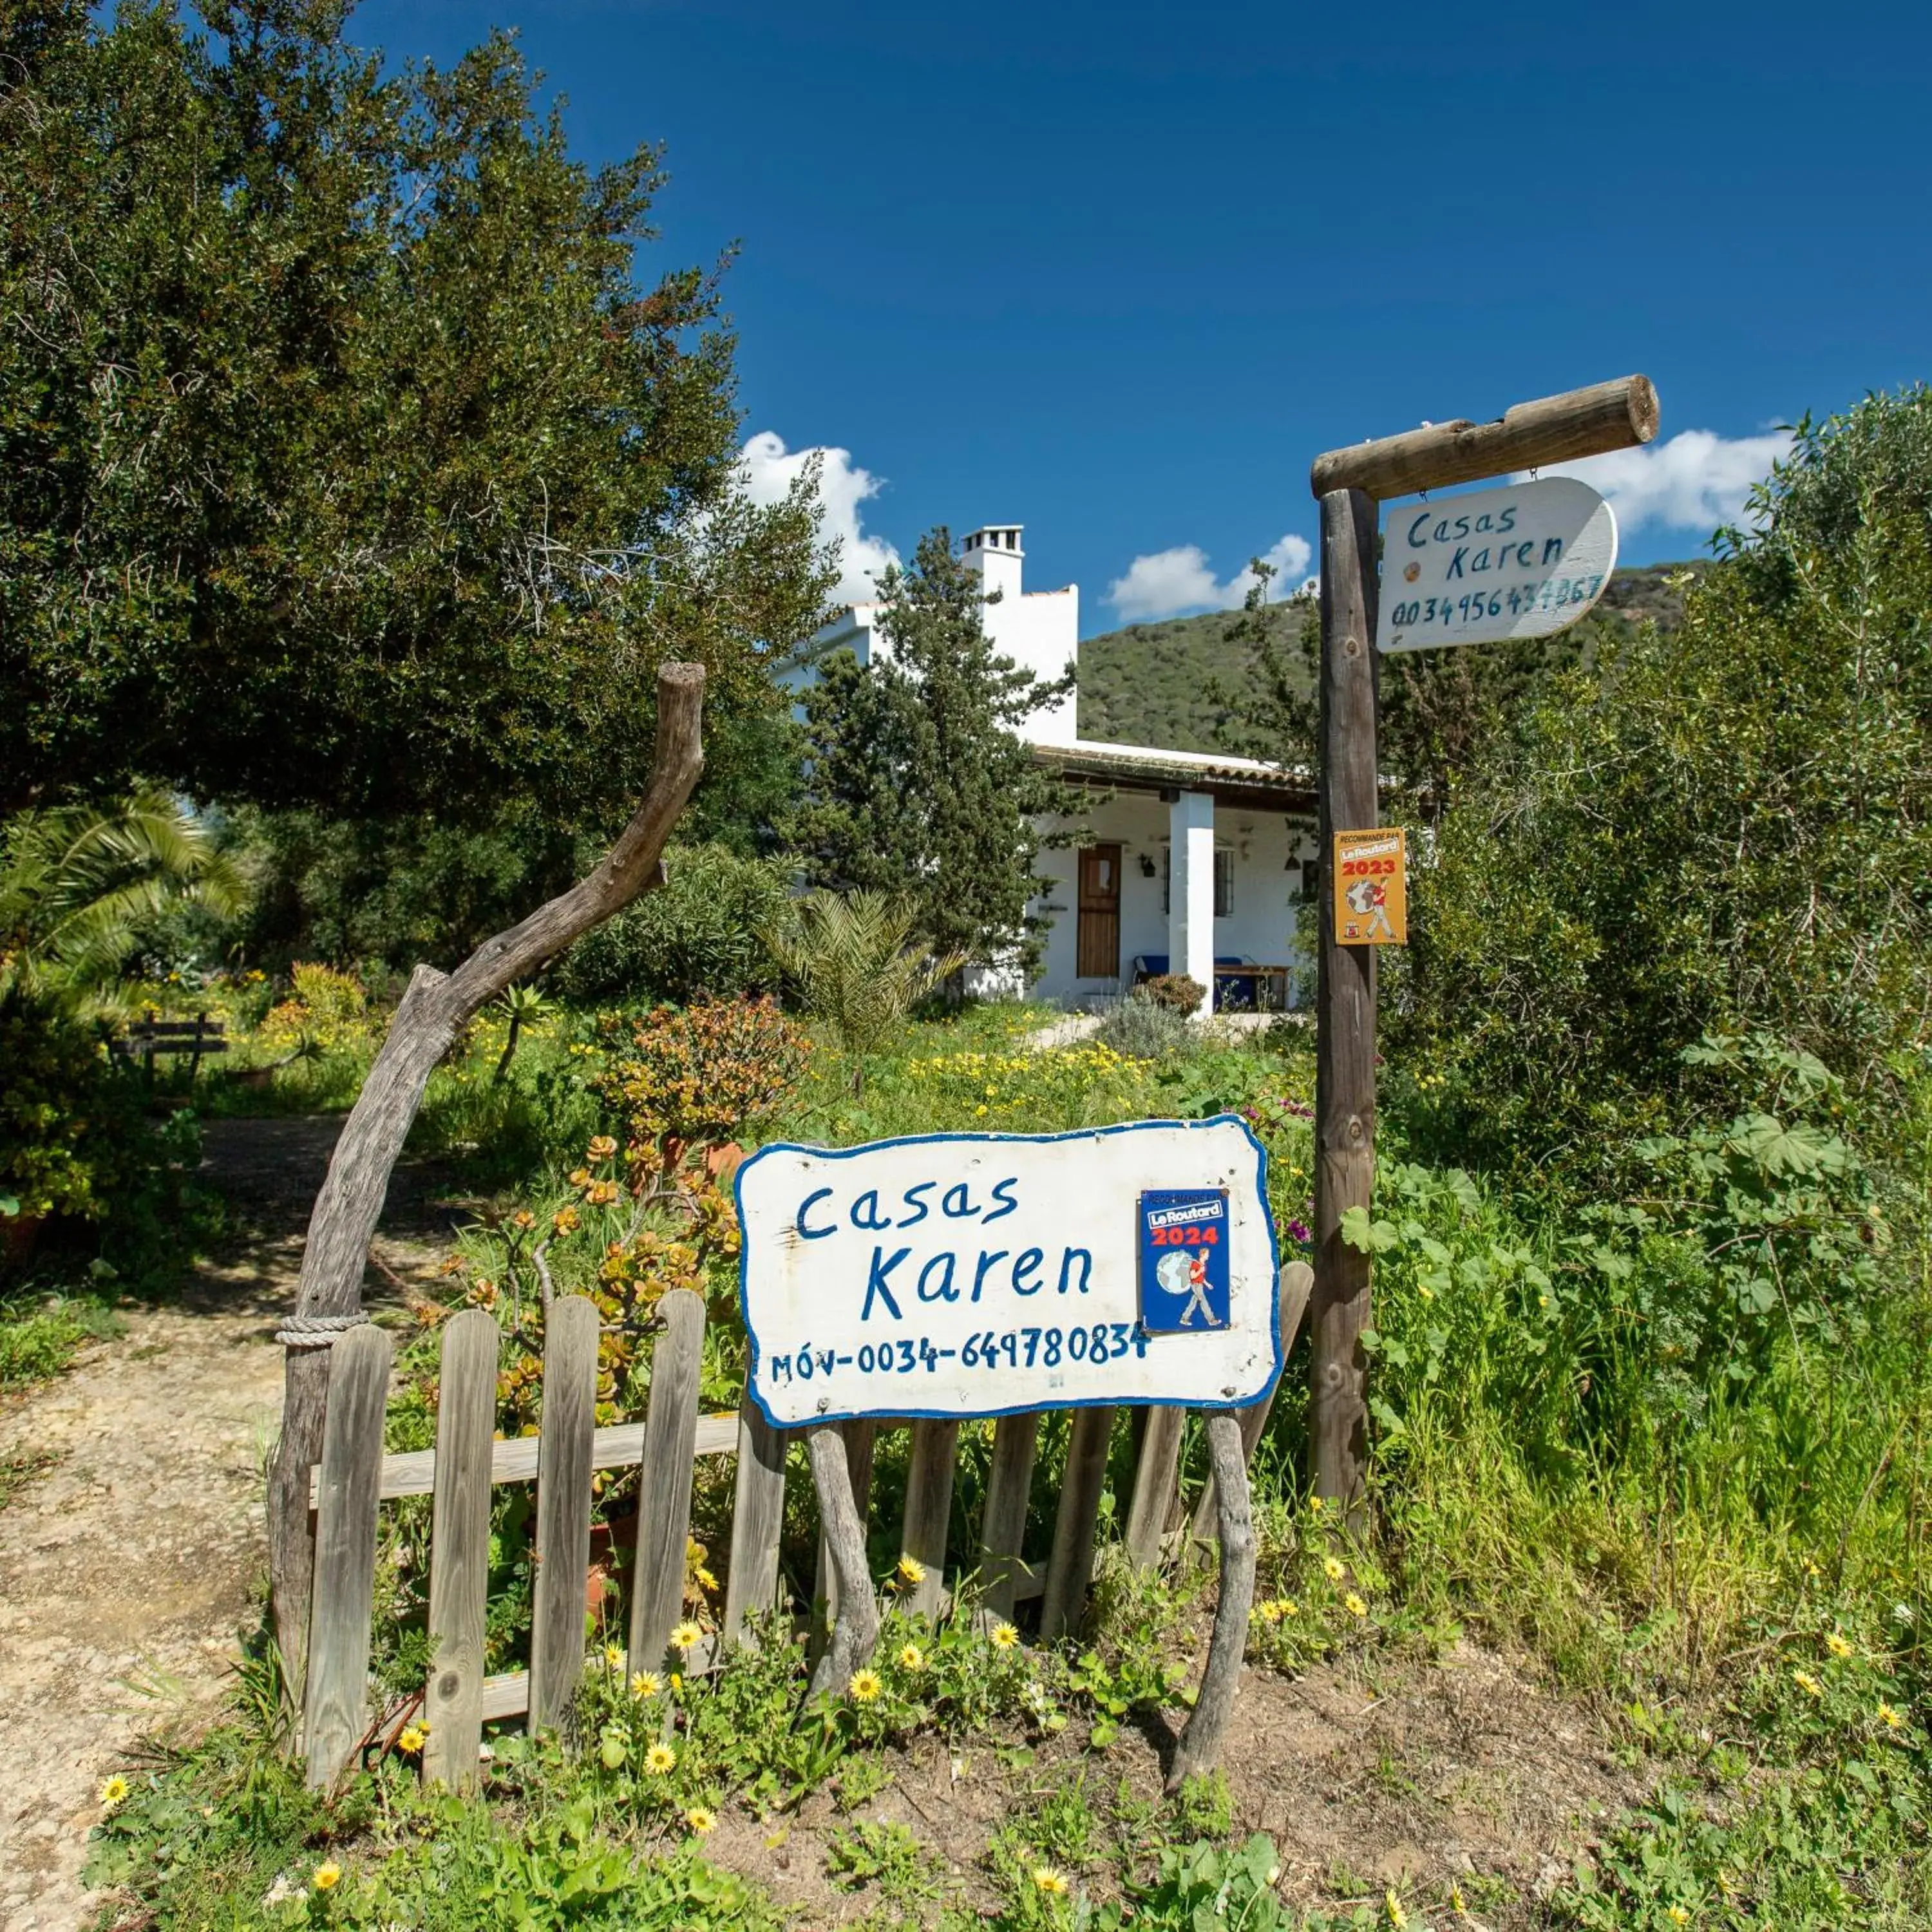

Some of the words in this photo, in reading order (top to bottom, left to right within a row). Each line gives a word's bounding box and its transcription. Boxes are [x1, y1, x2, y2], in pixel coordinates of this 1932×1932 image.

[1408, 506, 1517, 548] Casas
[1447, 537, 1562, 580] Karen
[1342, 860, 1396, 876] 2023
[797, 1177, 1019, 1240] Casas
[1152, 1227, 1218, 1245] 2024
[860, 1245, 1093, 1320] Karen
